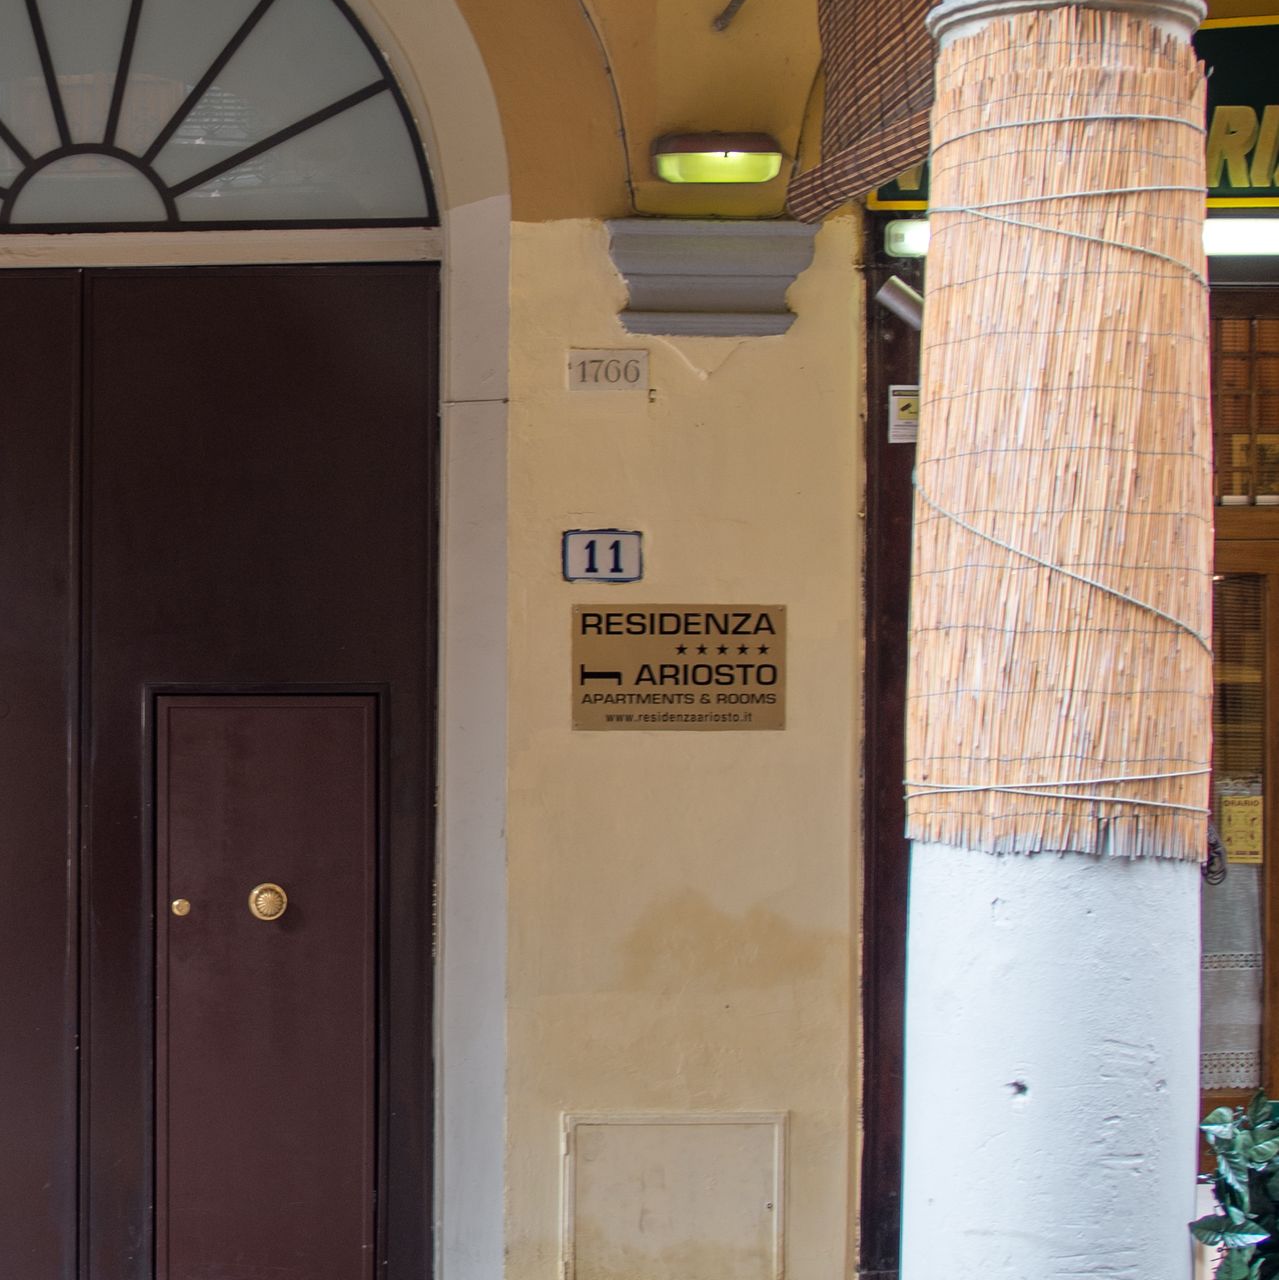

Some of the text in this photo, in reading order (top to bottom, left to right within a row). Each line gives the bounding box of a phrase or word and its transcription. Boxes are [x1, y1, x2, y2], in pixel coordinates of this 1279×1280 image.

[577, 358, 641, 383] 1766
[584, 539, 624, 574] 11
[580, 612, 776, 635] RESIDENZA
[634, 663, 778, 686] ARIOSTO
[581, 693, 777, 705] APARTMENTS & ROOMS
[605, 710, 753, 723] www.residenzaariosto.it
